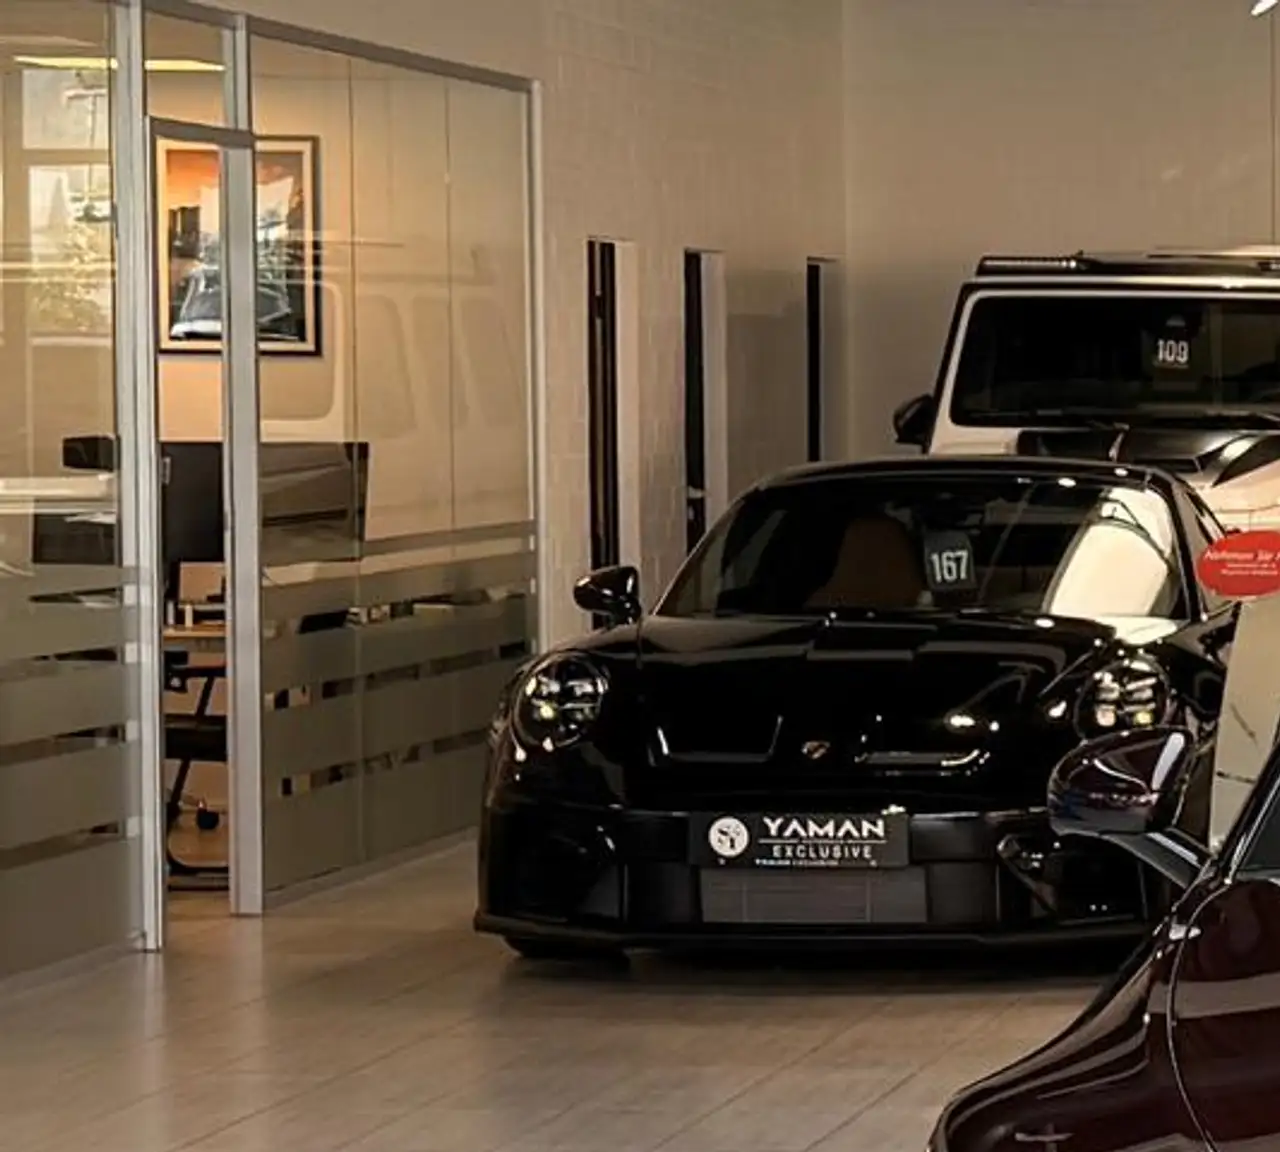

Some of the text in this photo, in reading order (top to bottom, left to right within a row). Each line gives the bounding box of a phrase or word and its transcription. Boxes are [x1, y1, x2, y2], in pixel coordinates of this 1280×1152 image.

[930, 549, 969, 583] 167
[762, 816, 886, 838] YAMAN
[772, 844, 873, 859] EXCLUSIVE
